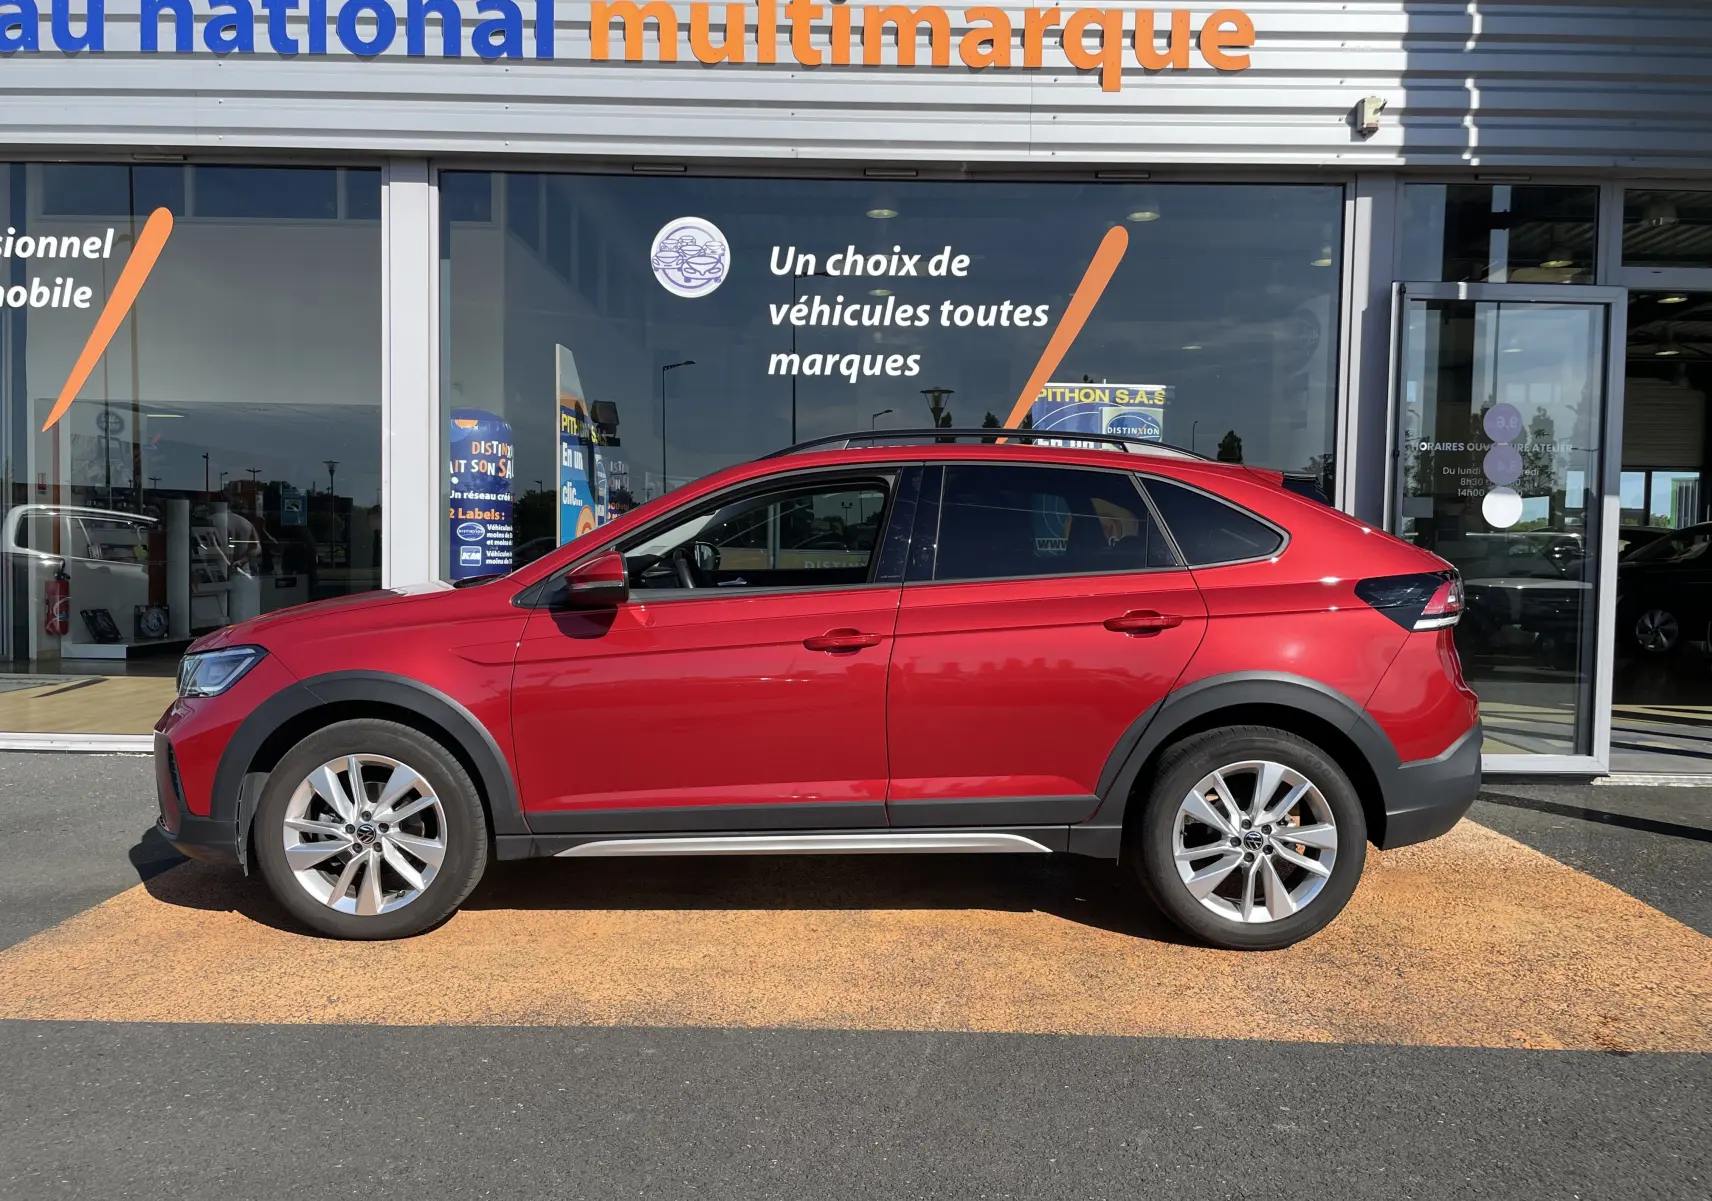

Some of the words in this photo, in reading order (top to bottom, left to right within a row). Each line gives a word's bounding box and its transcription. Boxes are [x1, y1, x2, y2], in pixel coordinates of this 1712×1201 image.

[141, 0, 555, 58] national
[591, 0, 1256, 92] multimarque
[0, 227, 115, 259] ionnel
[770, 246, 816, 276] Un
[826, 245, 922, 276] choix
[928, 245, 970, 276] de
[0, 277, 93, 309] obile
[770, 296, 930, 327] véhicules
[940, 300, 1050, 327] toutes
[768, 354, 920, 384] marques
[1034, 388, 1110, 403] PITHON
[1107, 425, 1160, 436] DISTINXION
[470, 459, 496, 476] SON
[562, 441, 573, 468] En
[574, 450, 584, 471] un
[1442, 466, 1455, 475] Du
[1457, 466, 1481, 475] lundi
[1460, 478, 1483, 486] 8h30
[463, 490, 497, 501] réseau
[1457, 488, 1485, 497] 14h00
